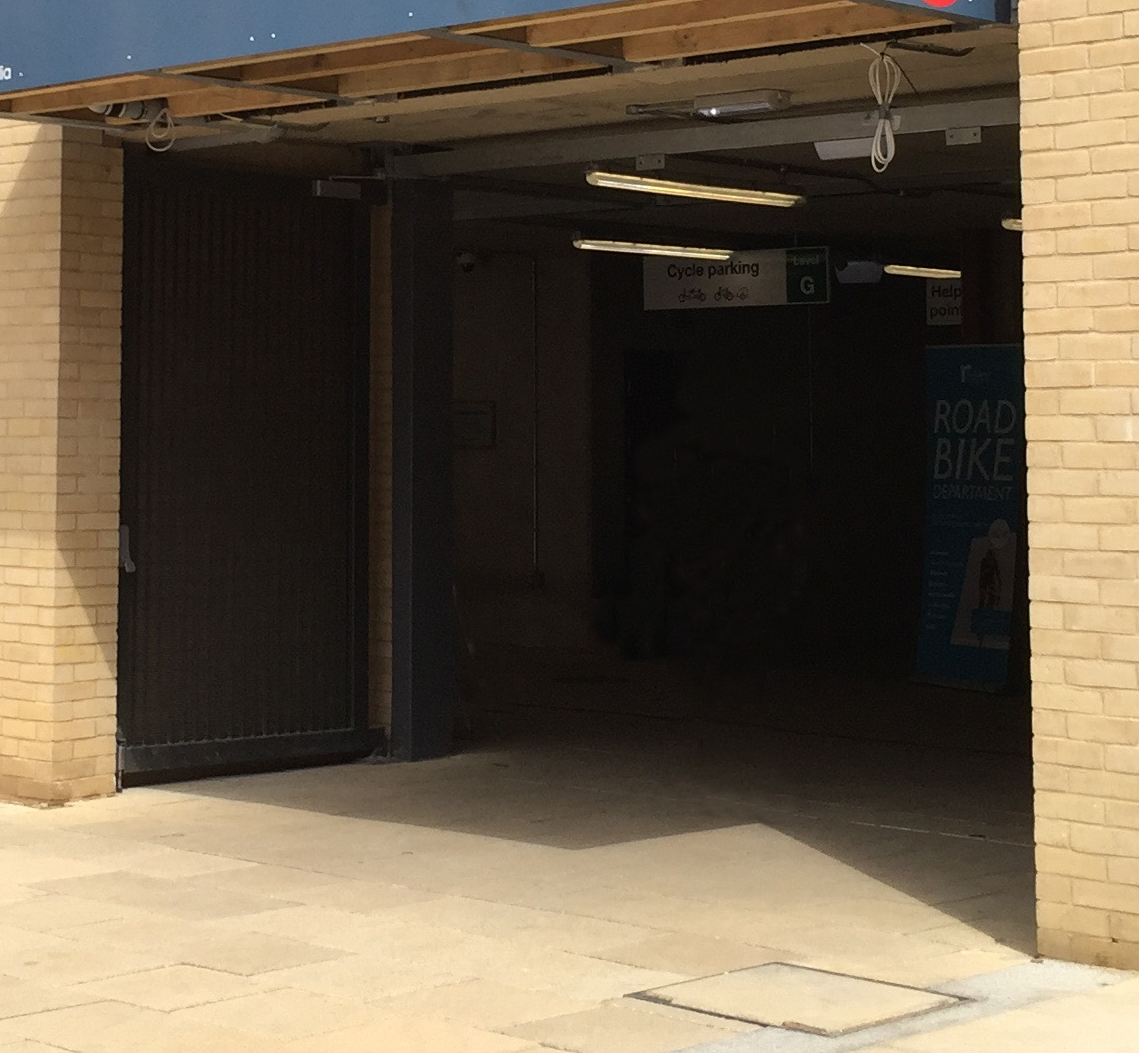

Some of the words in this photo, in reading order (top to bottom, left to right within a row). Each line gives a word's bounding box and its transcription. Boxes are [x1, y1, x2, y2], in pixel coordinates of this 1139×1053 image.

[667, 263, 704, 279] Cycle
[707, 260, 760, 278] parking
[799, 275, 816, 295] G
[931, 284, 962, 301] Help
[933, 399, 1017, 434] ROAD
[933, 437, 1016, 481] BIKE
[932, 483, 1012, 500] DEPARTMENT
